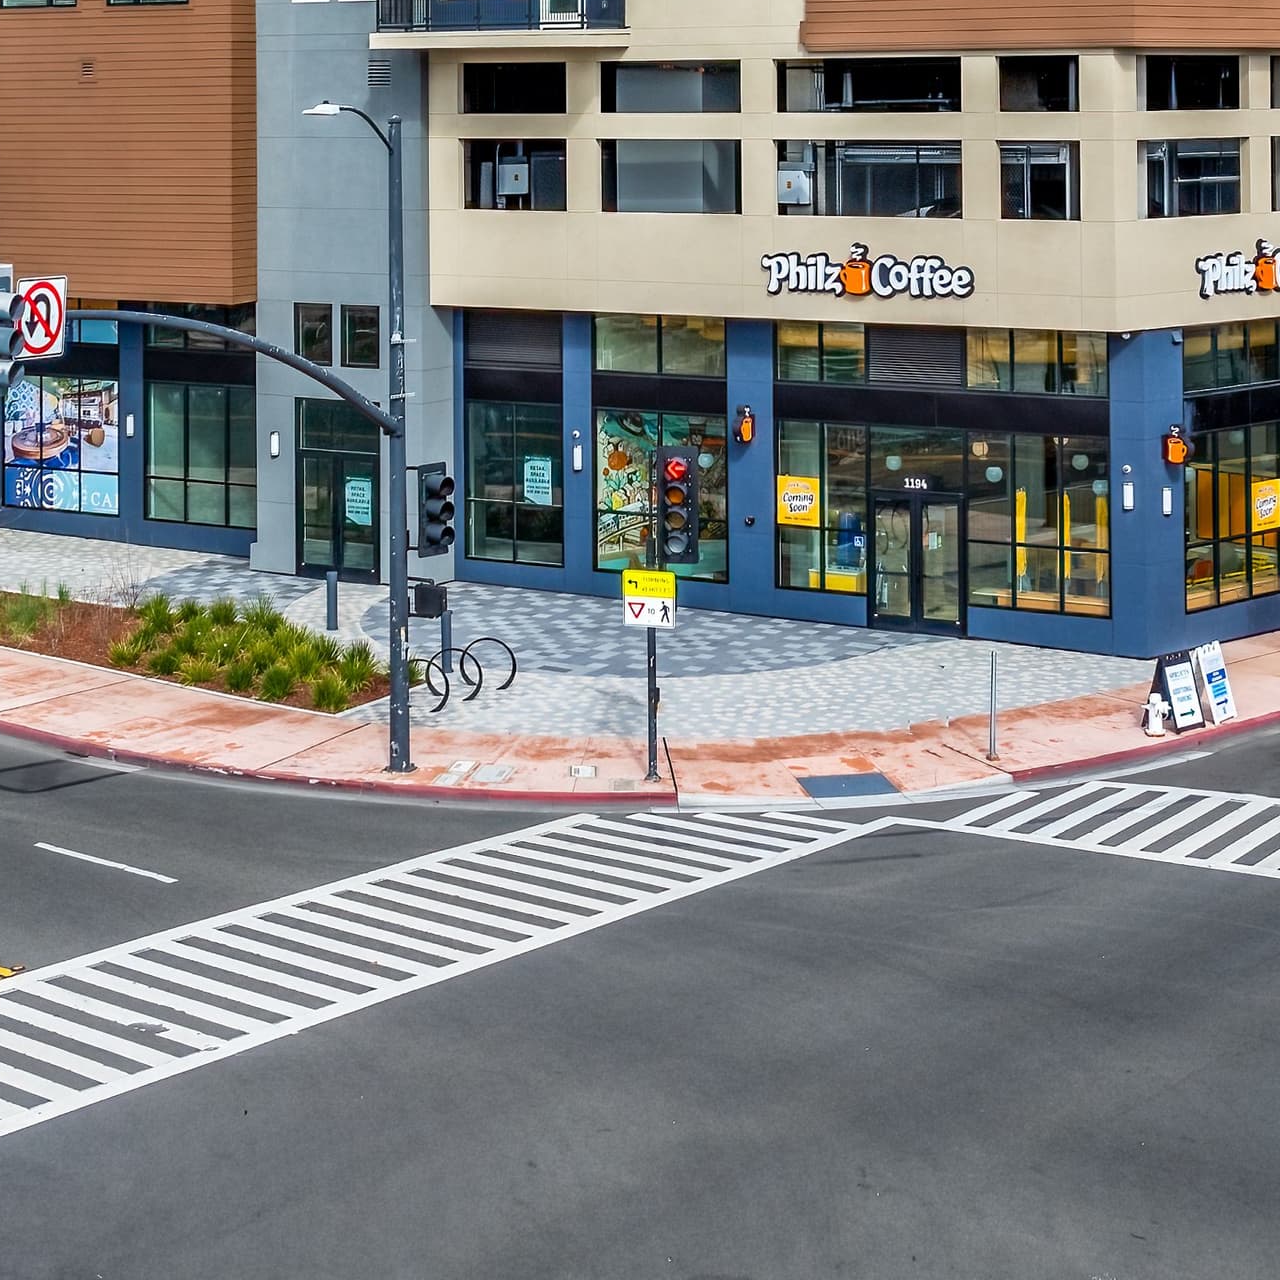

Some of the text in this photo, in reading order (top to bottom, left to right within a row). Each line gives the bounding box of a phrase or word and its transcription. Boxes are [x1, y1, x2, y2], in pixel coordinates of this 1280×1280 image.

[761, 252, 975, 299] Philz Coffee
[1195, 251, 1257, 300] Philz
[904, 477, 927, 490] 1194
[783, 492, 814, 504] Coming
[789, 502, 808, 513] Soon
